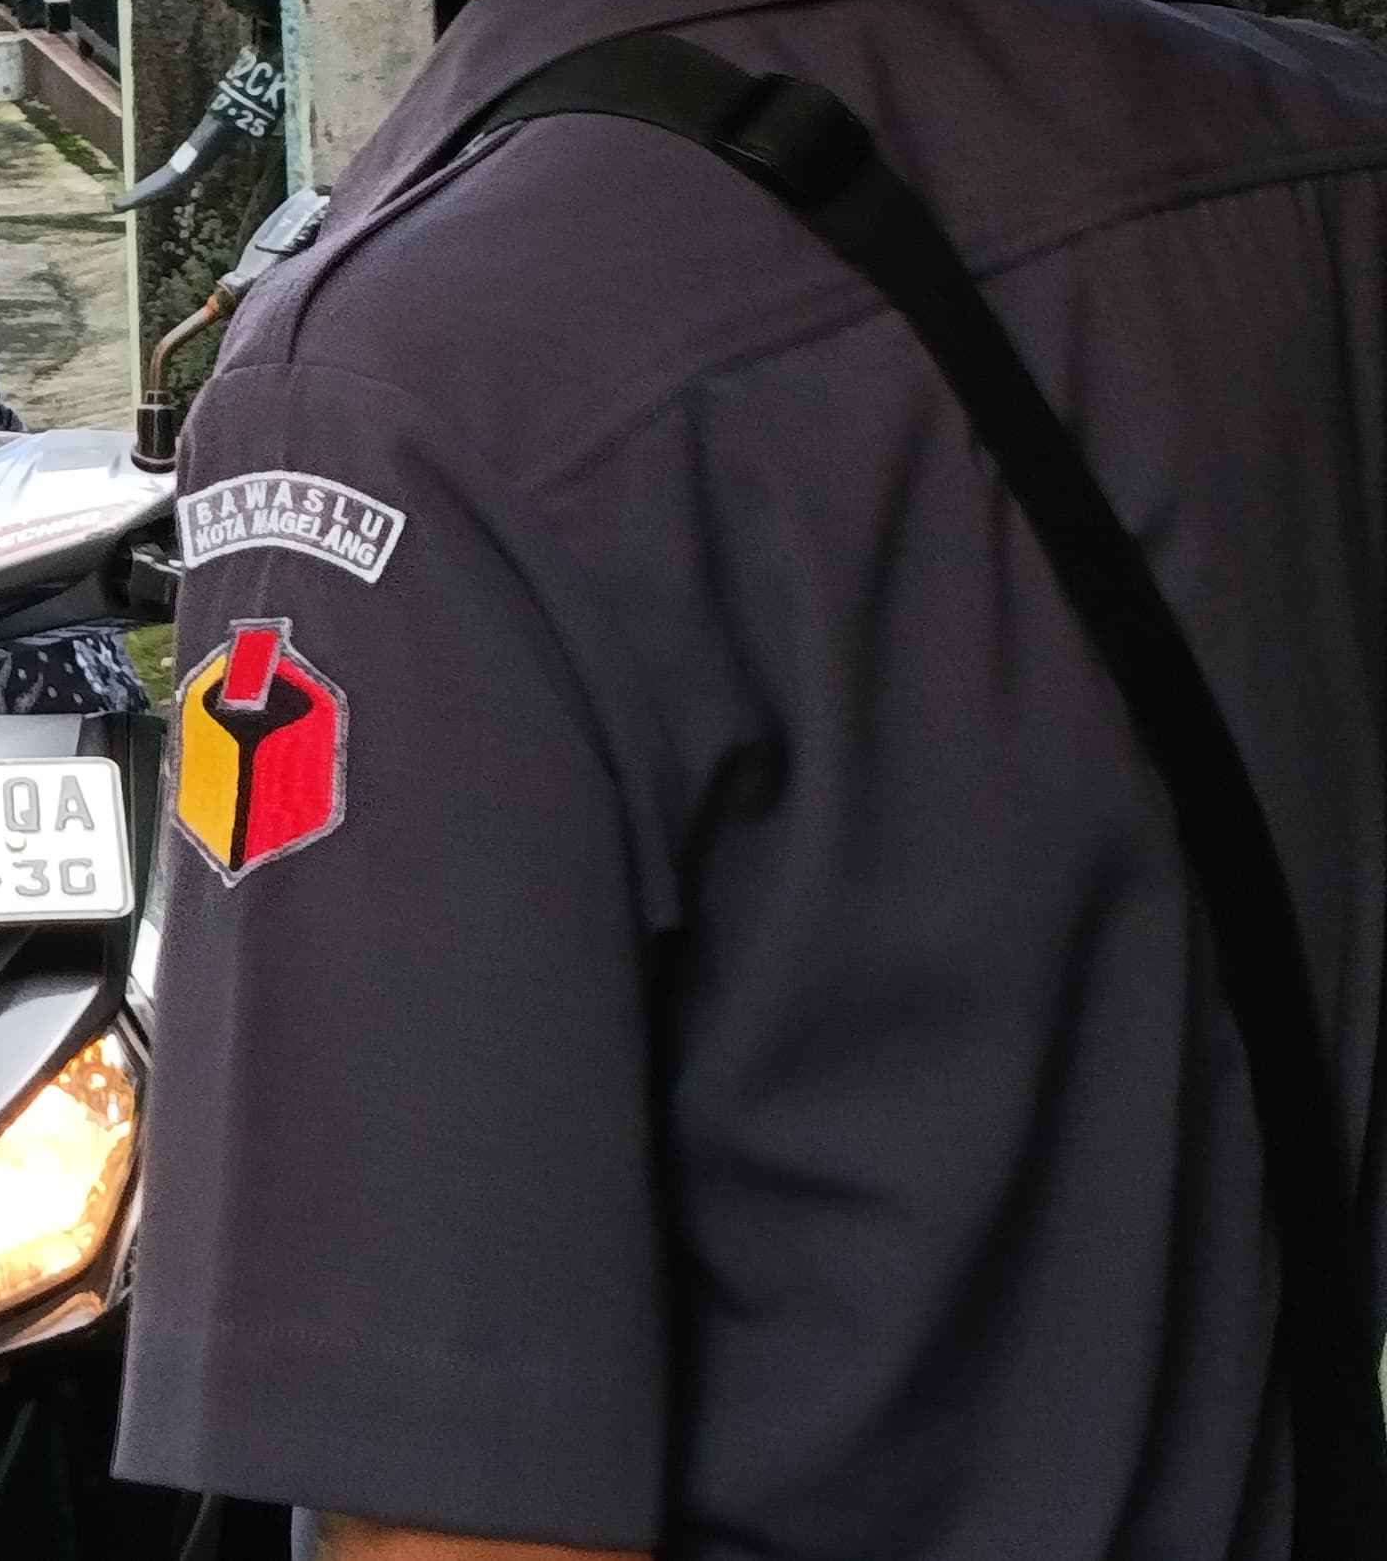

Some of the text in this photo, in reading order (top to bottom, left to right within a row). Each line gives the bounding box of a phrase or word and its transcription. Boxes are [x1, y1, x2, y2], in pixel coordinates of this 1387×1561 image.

[194, 507, 378, 566] KOTA MAGELANG
[195, 481, 385, 540] BAWASLU
[2, 775, 96, 833] QA
